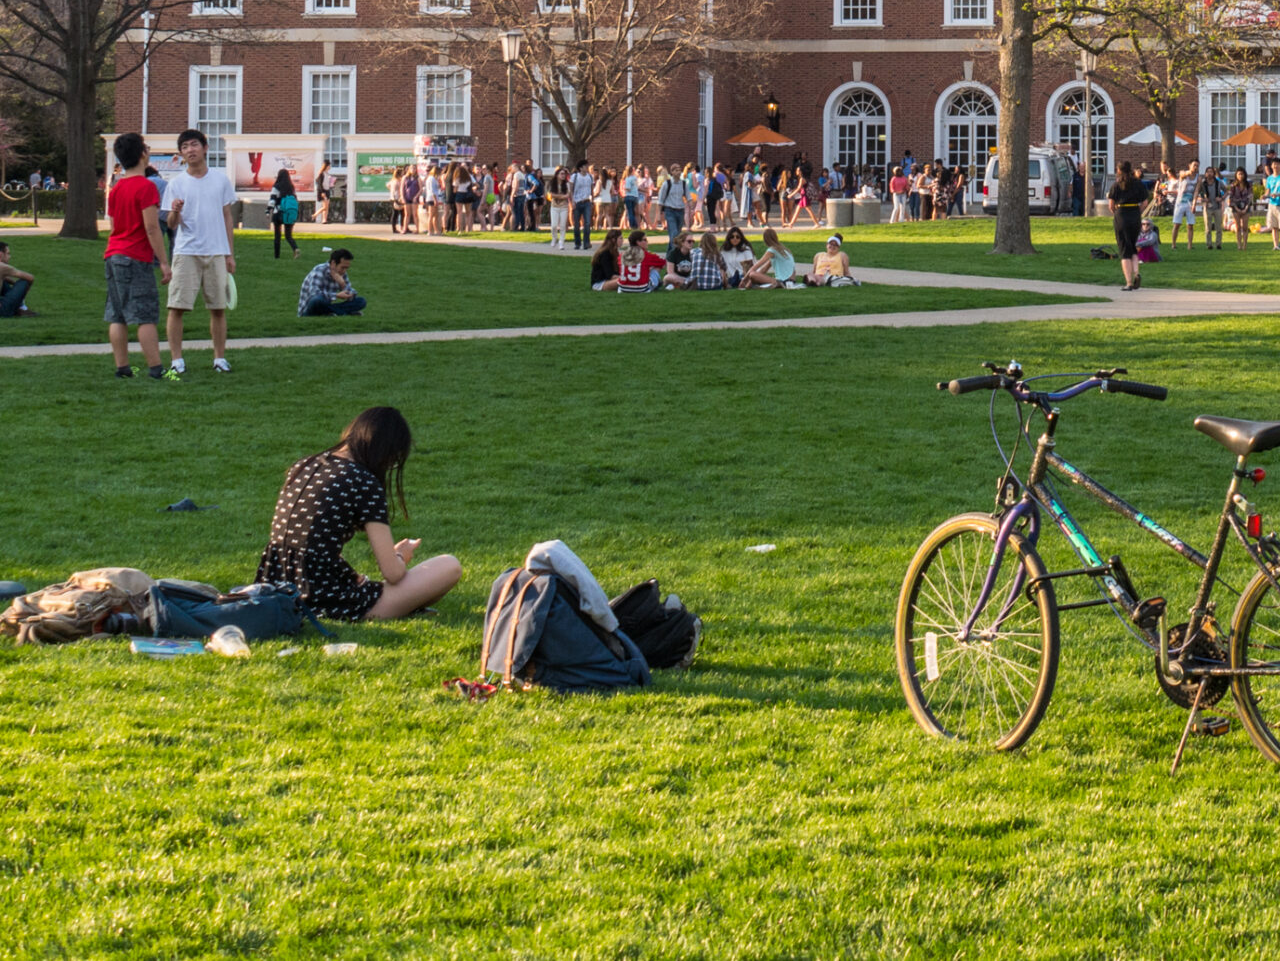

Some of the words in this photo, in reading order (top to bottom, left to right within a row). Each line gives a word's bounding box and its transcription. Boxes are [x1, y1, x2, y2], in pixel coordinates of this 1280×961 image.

[369, 156, 393, 164] LOOKING
[394, 156, 405, 164] FOR
[620, 262, 642, 281] 19
